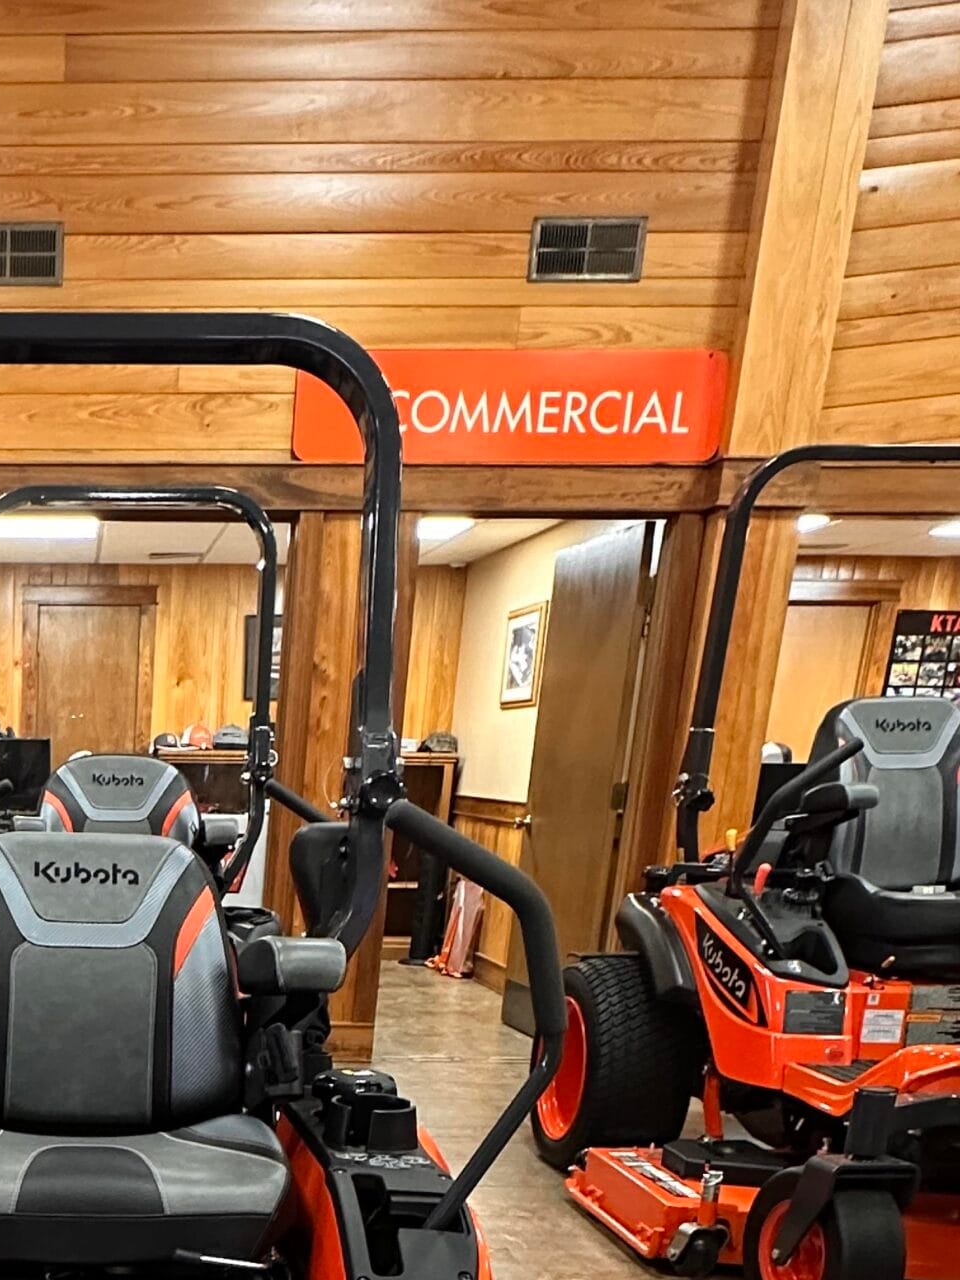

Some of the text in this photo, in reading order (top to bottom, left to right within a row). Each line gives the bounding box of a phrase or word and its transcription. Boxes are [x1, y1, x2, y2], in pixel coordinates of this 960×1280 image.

[876, 718, 932, 732] Kubota
[92, 773, 144, 787] Kubota
[34, 861, 140, 886] Kubota
[702, 932, 746, 999] Kubota
